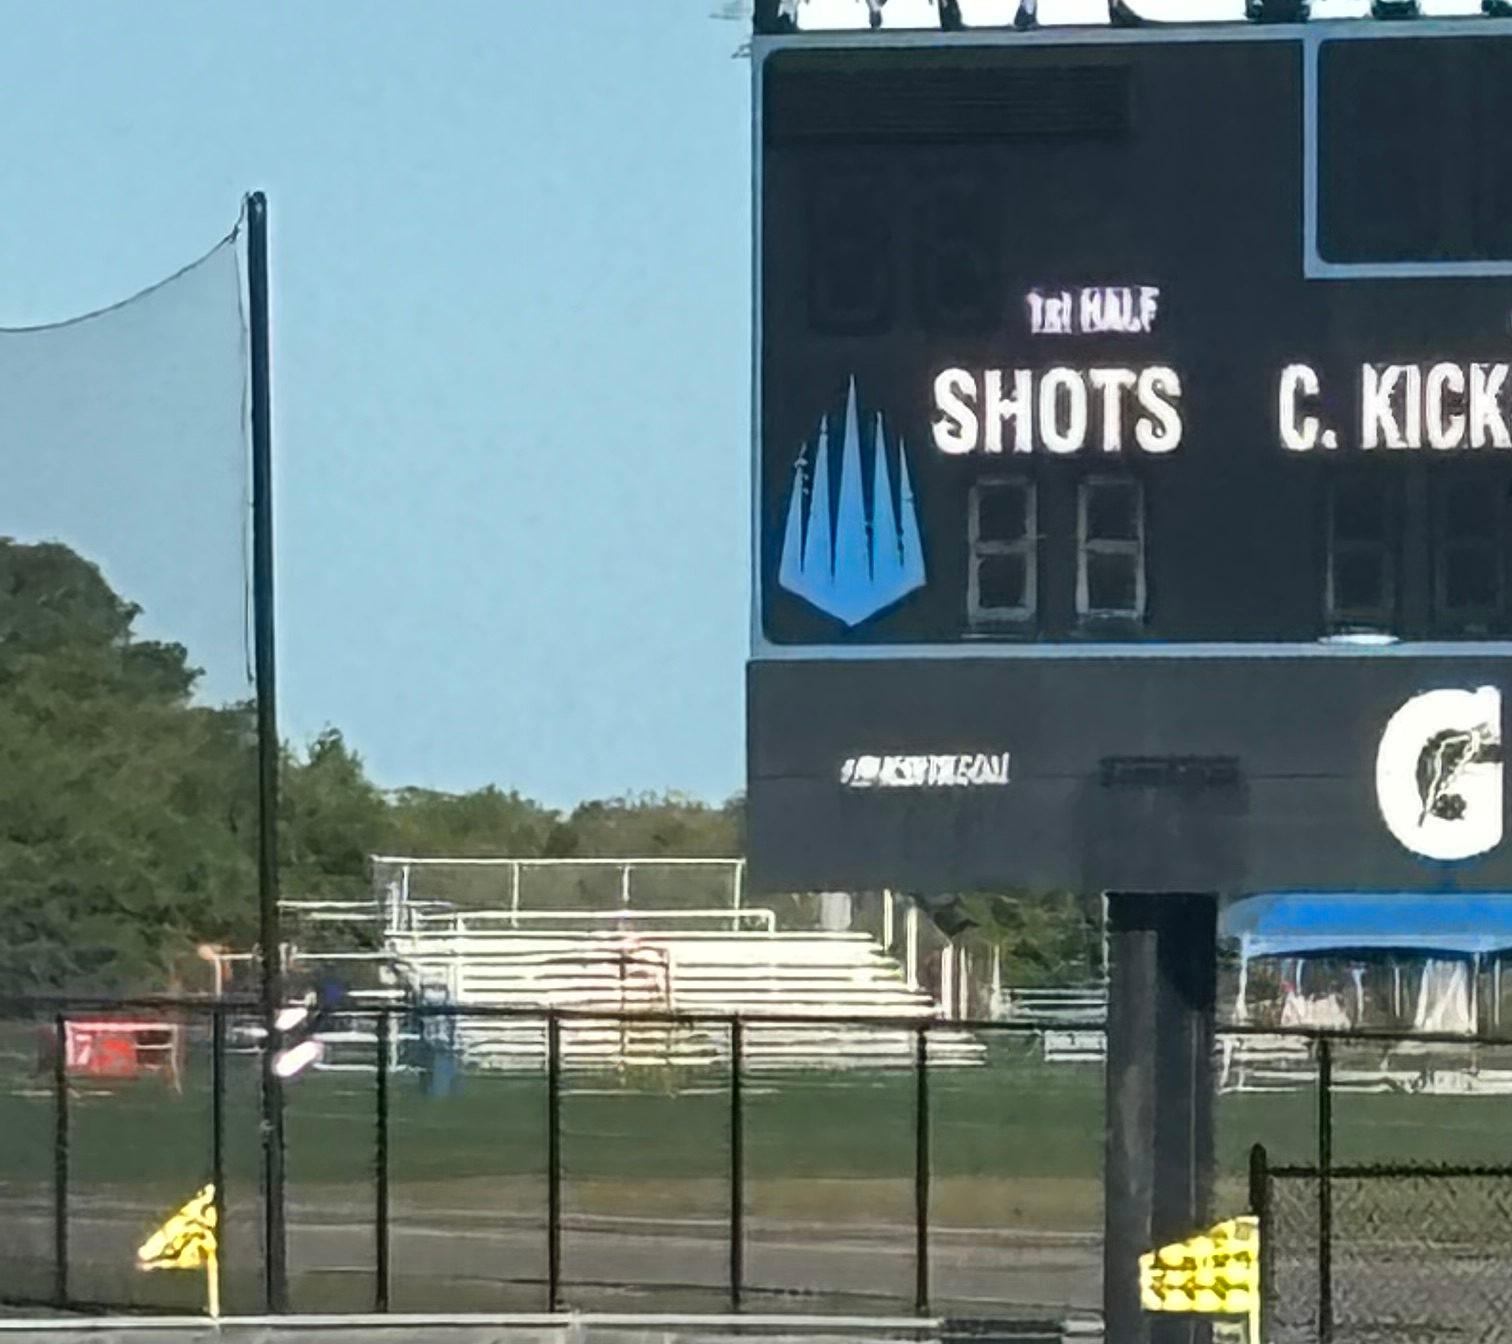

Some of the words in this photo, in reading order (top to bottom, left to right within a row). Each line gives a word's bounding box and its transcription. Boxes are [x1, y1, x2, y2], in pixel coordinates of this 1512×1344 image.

[1080, 286, 1160, 333] HALF
[930, 365, 1184, 455] SHOTS
[1278, 362, 1338, 452] C.
